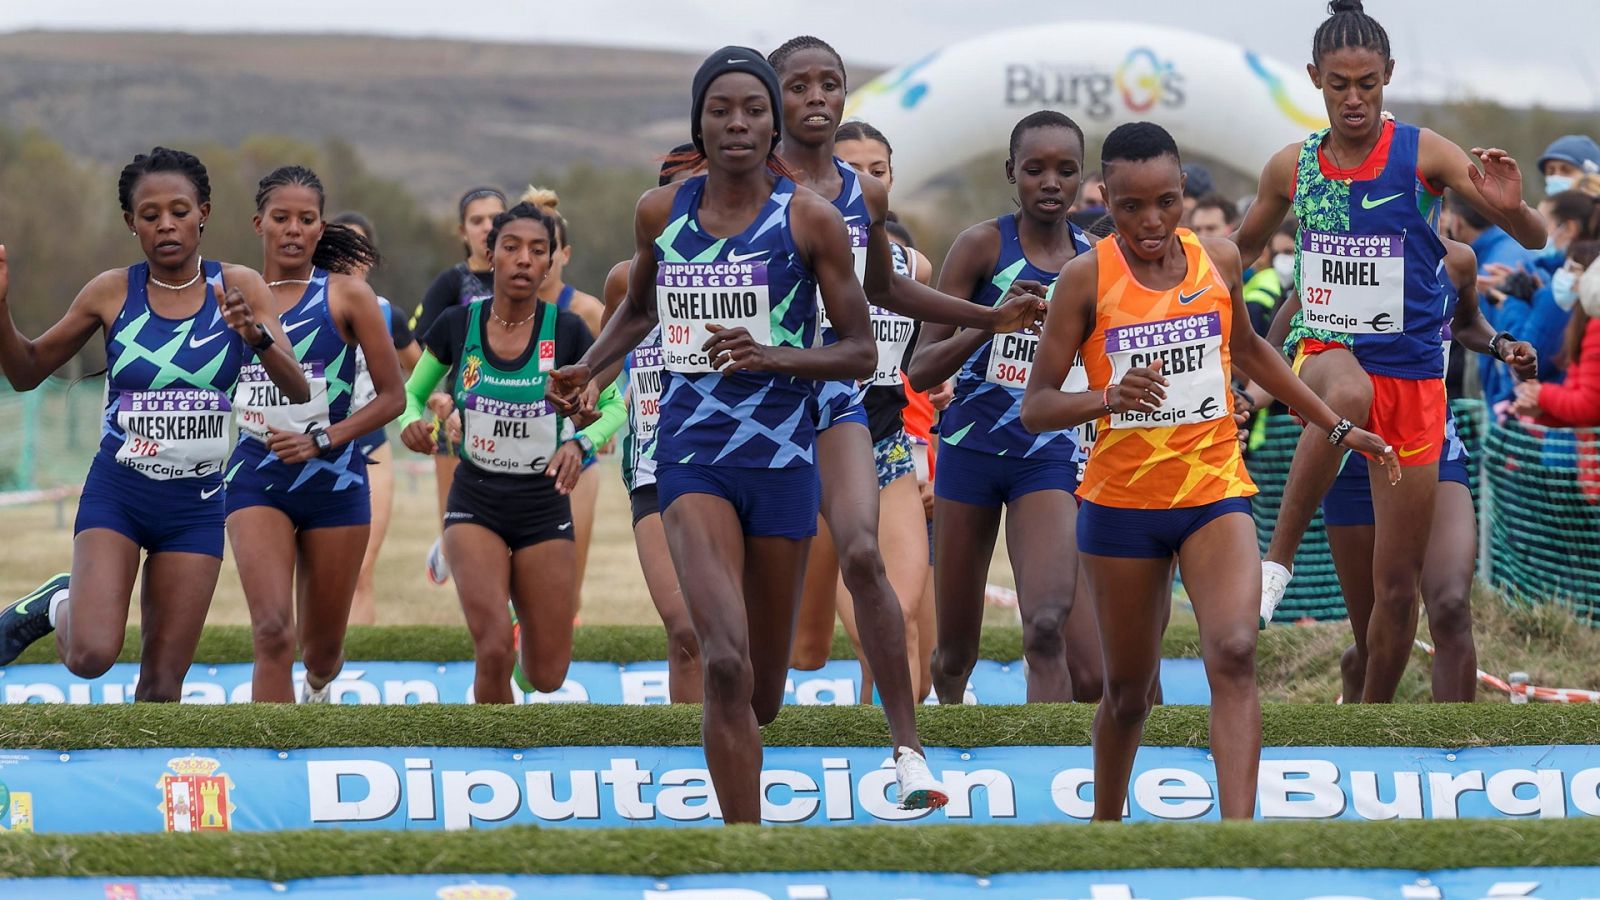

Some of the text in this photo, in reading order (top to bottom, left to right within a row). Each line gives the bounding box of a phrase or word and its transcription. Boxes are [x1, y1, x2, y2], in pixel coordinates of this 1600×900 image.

[1005, 48, 1187, 121] Burgos
[1311, 232, 1391, 247] DIPUTACIÓN
[1311, 242, 1391, 257] BURGOS
[665, 263, 752, 275] DIPUTACIÓN
[1322, 259, 1380, 287] RAHEL
[664, 274, 753, 287] BURGOS
[1307, 286, 1332, 305] 327
[667, 291, 758, 320] CHELIMO
[1118, 315, 1208, 339] DIPUTACIÓN
[1306, 309, 1358, 329] iberCaja
[668, 324, 690, 345] 301
[1118, 325, 1210, 351] BURGOS
[483, 375, 530, 389] VILLARREAL
[996, 363, 1026, 384] 304
[131, 390, 219, 401] DIPUTACIÓN
[476, 396, 546, 411] DIPUTACIÓN
[132, 400, 219, 411] BURGOS
[476, 403, 547, 418] BURGOS
[640, 400, 660, 416] 306
[128, 415, 225, 441] MESKERAM
[493, 420, 530, 439] AYEL
[130, 438, 159, 457] 316
[472, 435, 496, 453] 312
[471, 451, 519, 470] iberCaja
[306, 757, 1017, 830] Diputación
